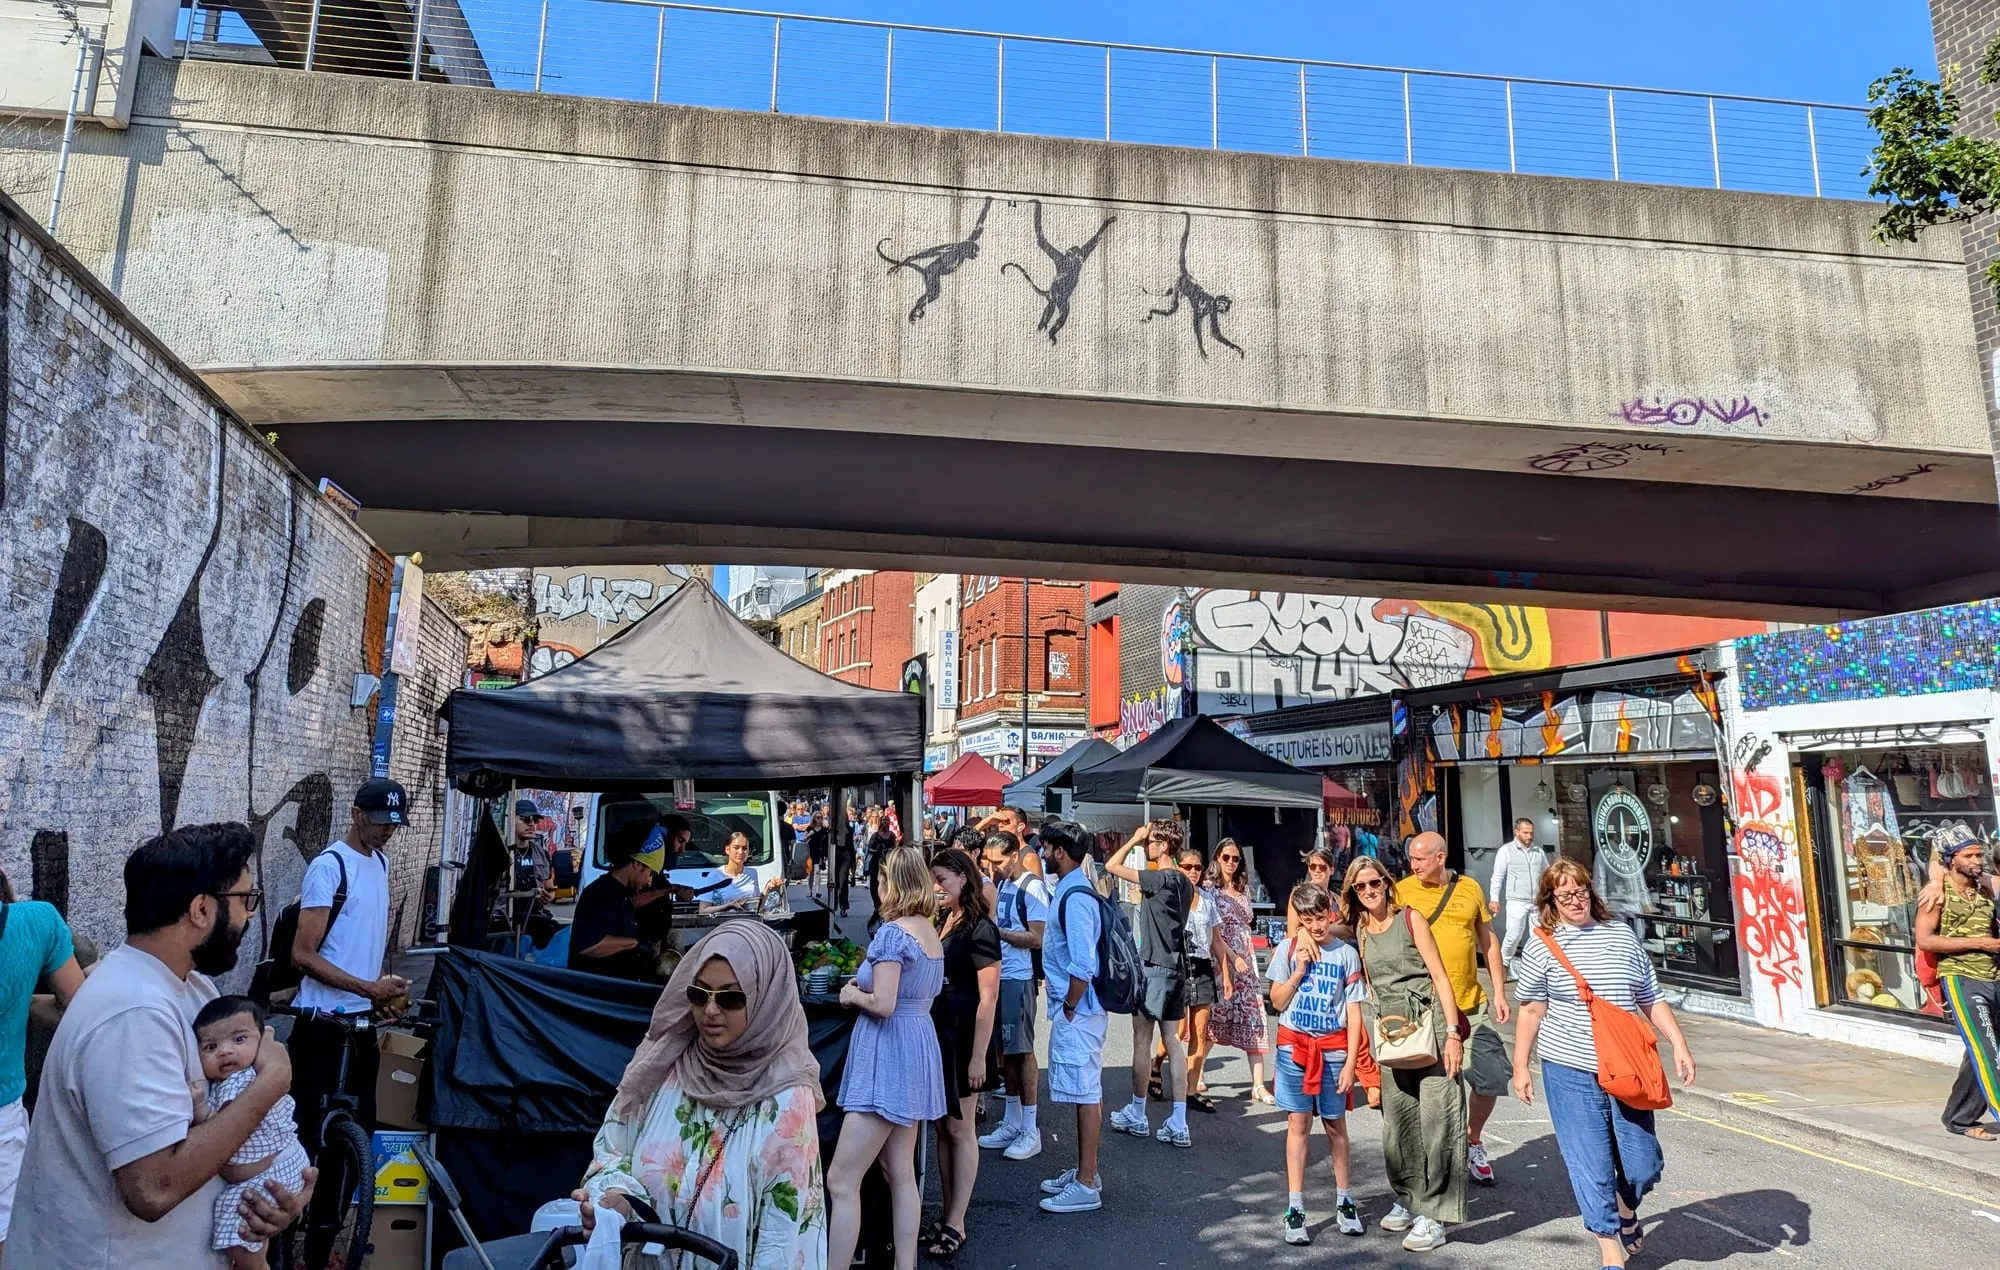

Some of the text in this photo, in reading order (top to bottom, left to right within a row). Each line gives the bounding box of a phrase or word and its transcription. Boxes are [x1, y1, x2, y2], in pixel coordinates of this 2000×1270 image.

[1276, 738, 1320, 759] FUTURE
[1321, 738, 1332, 757] IS
[1335, 733, 1361, 756] HOT
[1597, 793, 1648, 831] CHIVALROUS GROOMING
[1293, 960, 1346, 979] USTON
[1317, 979, 1337, 995] WE
[1296, 996, 1337, 1014] HAVE A
[1290, 1012, 1341, 1030] PROBLEM
